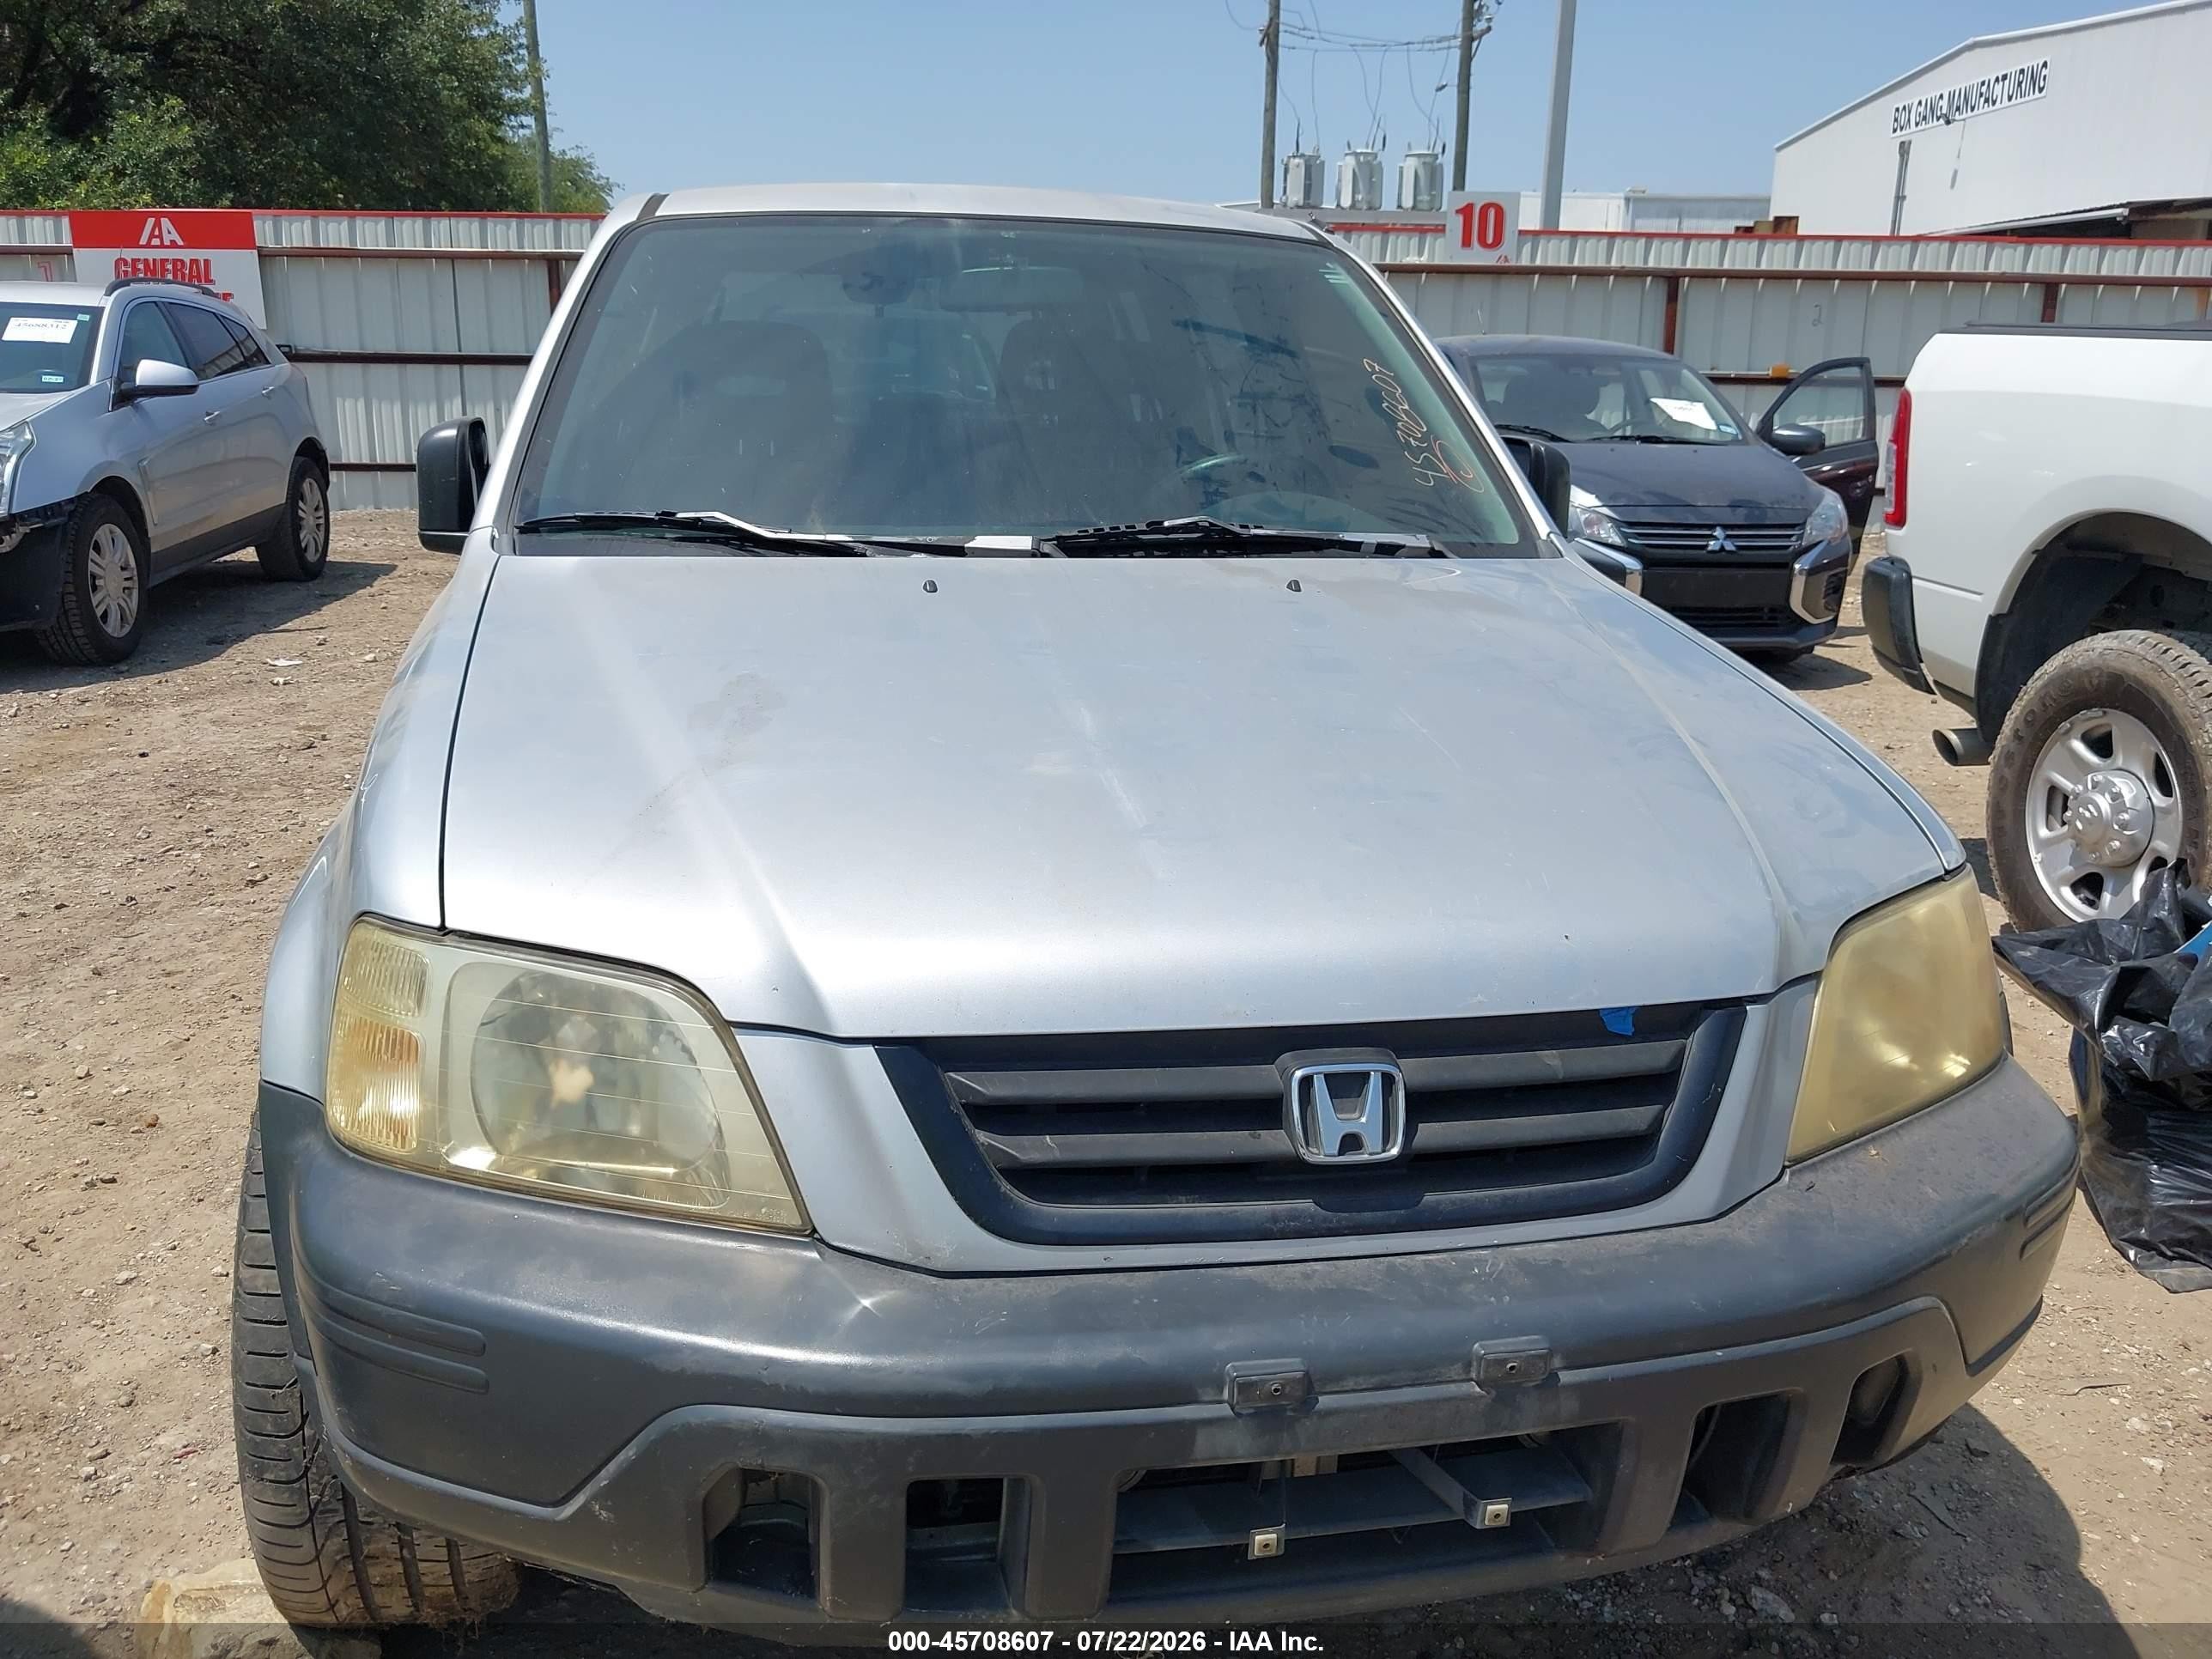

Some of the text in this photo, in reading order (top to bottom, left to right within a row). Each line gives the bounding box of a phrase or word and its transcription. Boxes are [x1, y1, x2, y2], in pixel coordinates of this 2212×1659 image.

[1892, 60, 2048, 134] BOX GANG MANUFACTURING
[1455, 201, 1506, 251] 10
[114, 258, 216, 286] GENERAL
